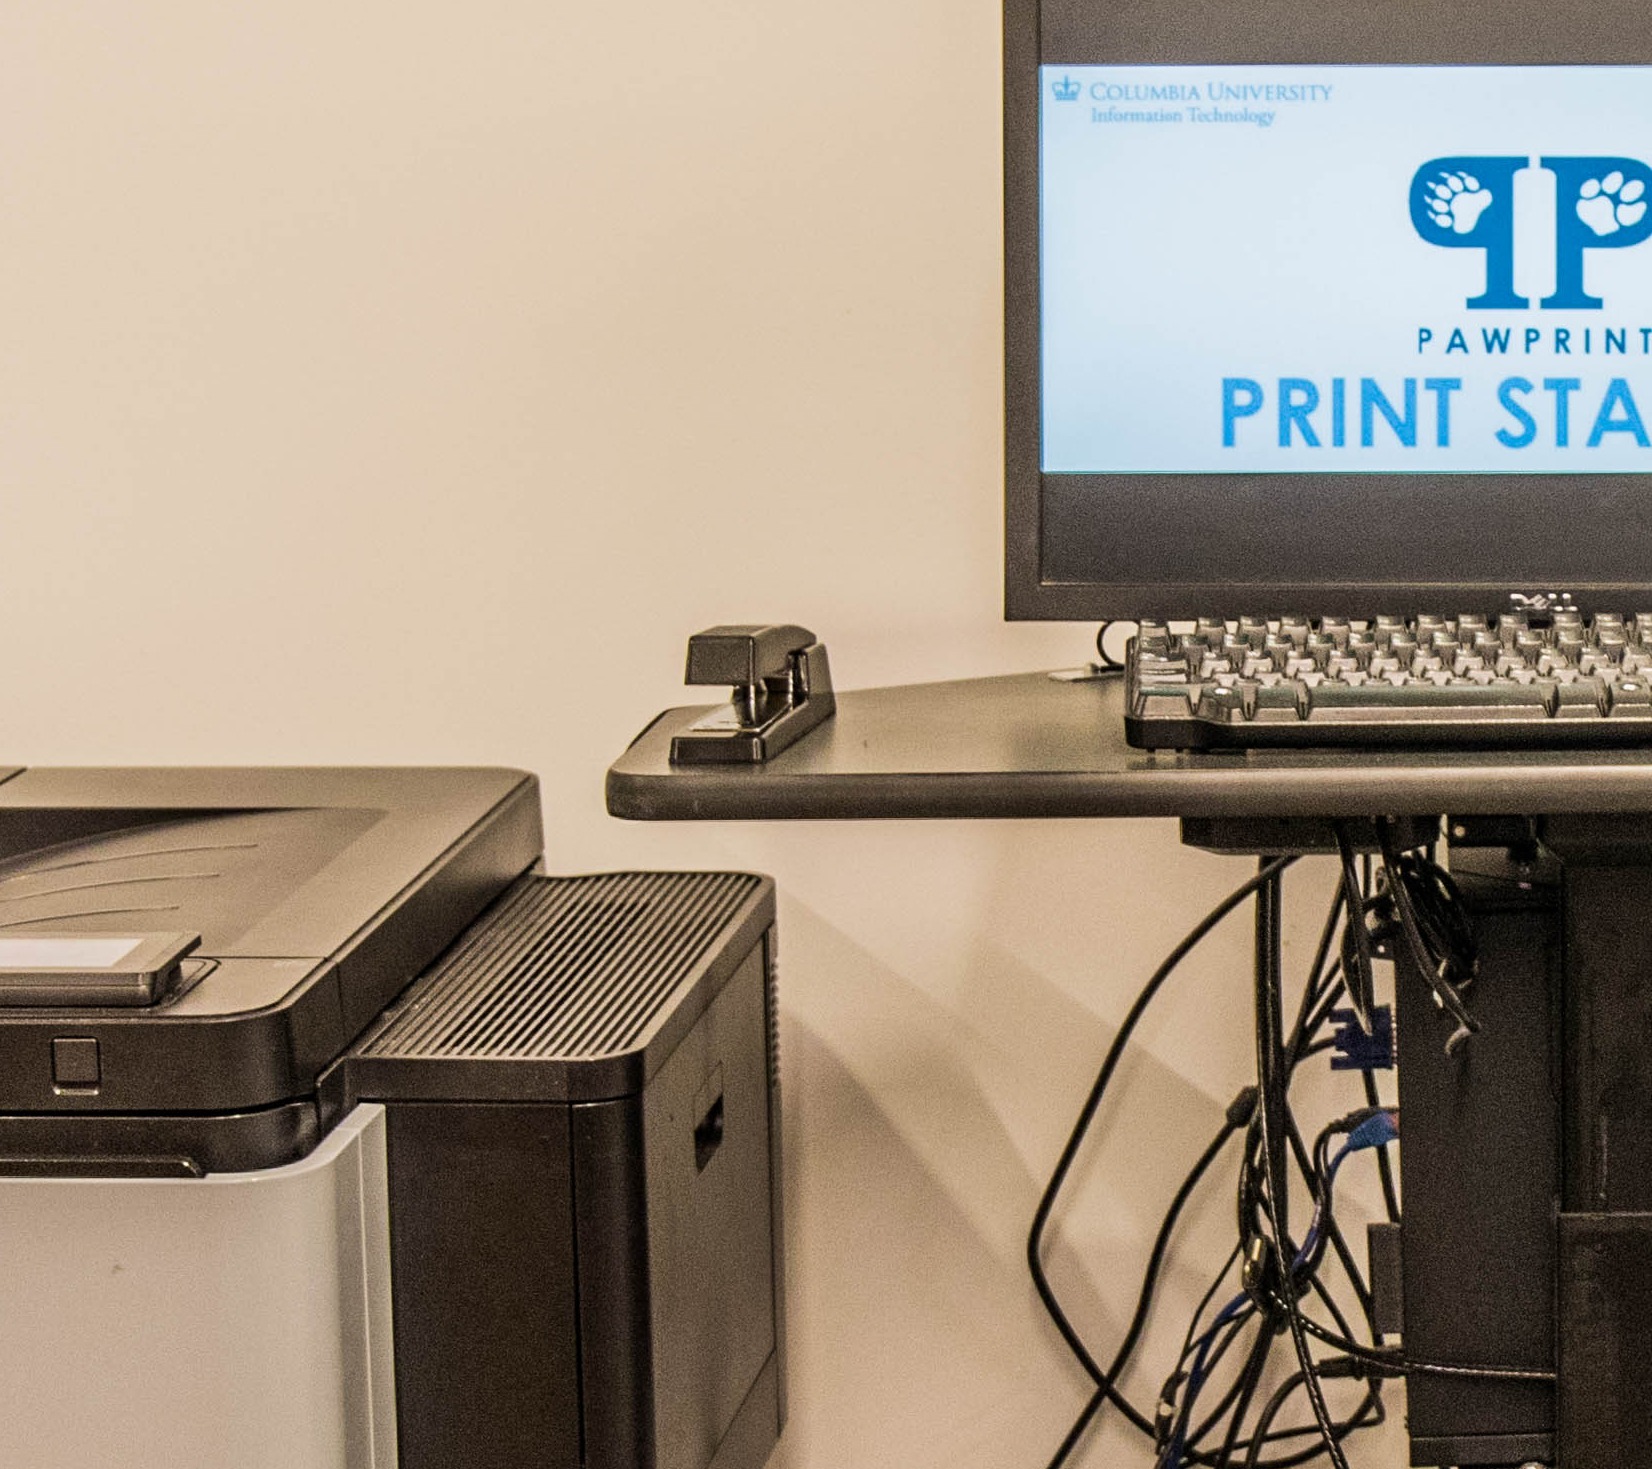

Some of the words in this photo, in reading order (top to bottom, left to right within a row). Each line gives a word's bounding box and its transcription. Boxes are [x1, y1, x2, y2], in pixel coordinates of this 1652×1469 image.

[1089, 82, 1199, 101] COLUMBIA
[1207, 82, 1333, 102] UNIVERSITY
[1091, 106, 1183, 124] Information
[1187, 106, 1275, 128] Technology
[1221, 377, 1462, 449] PRINT
